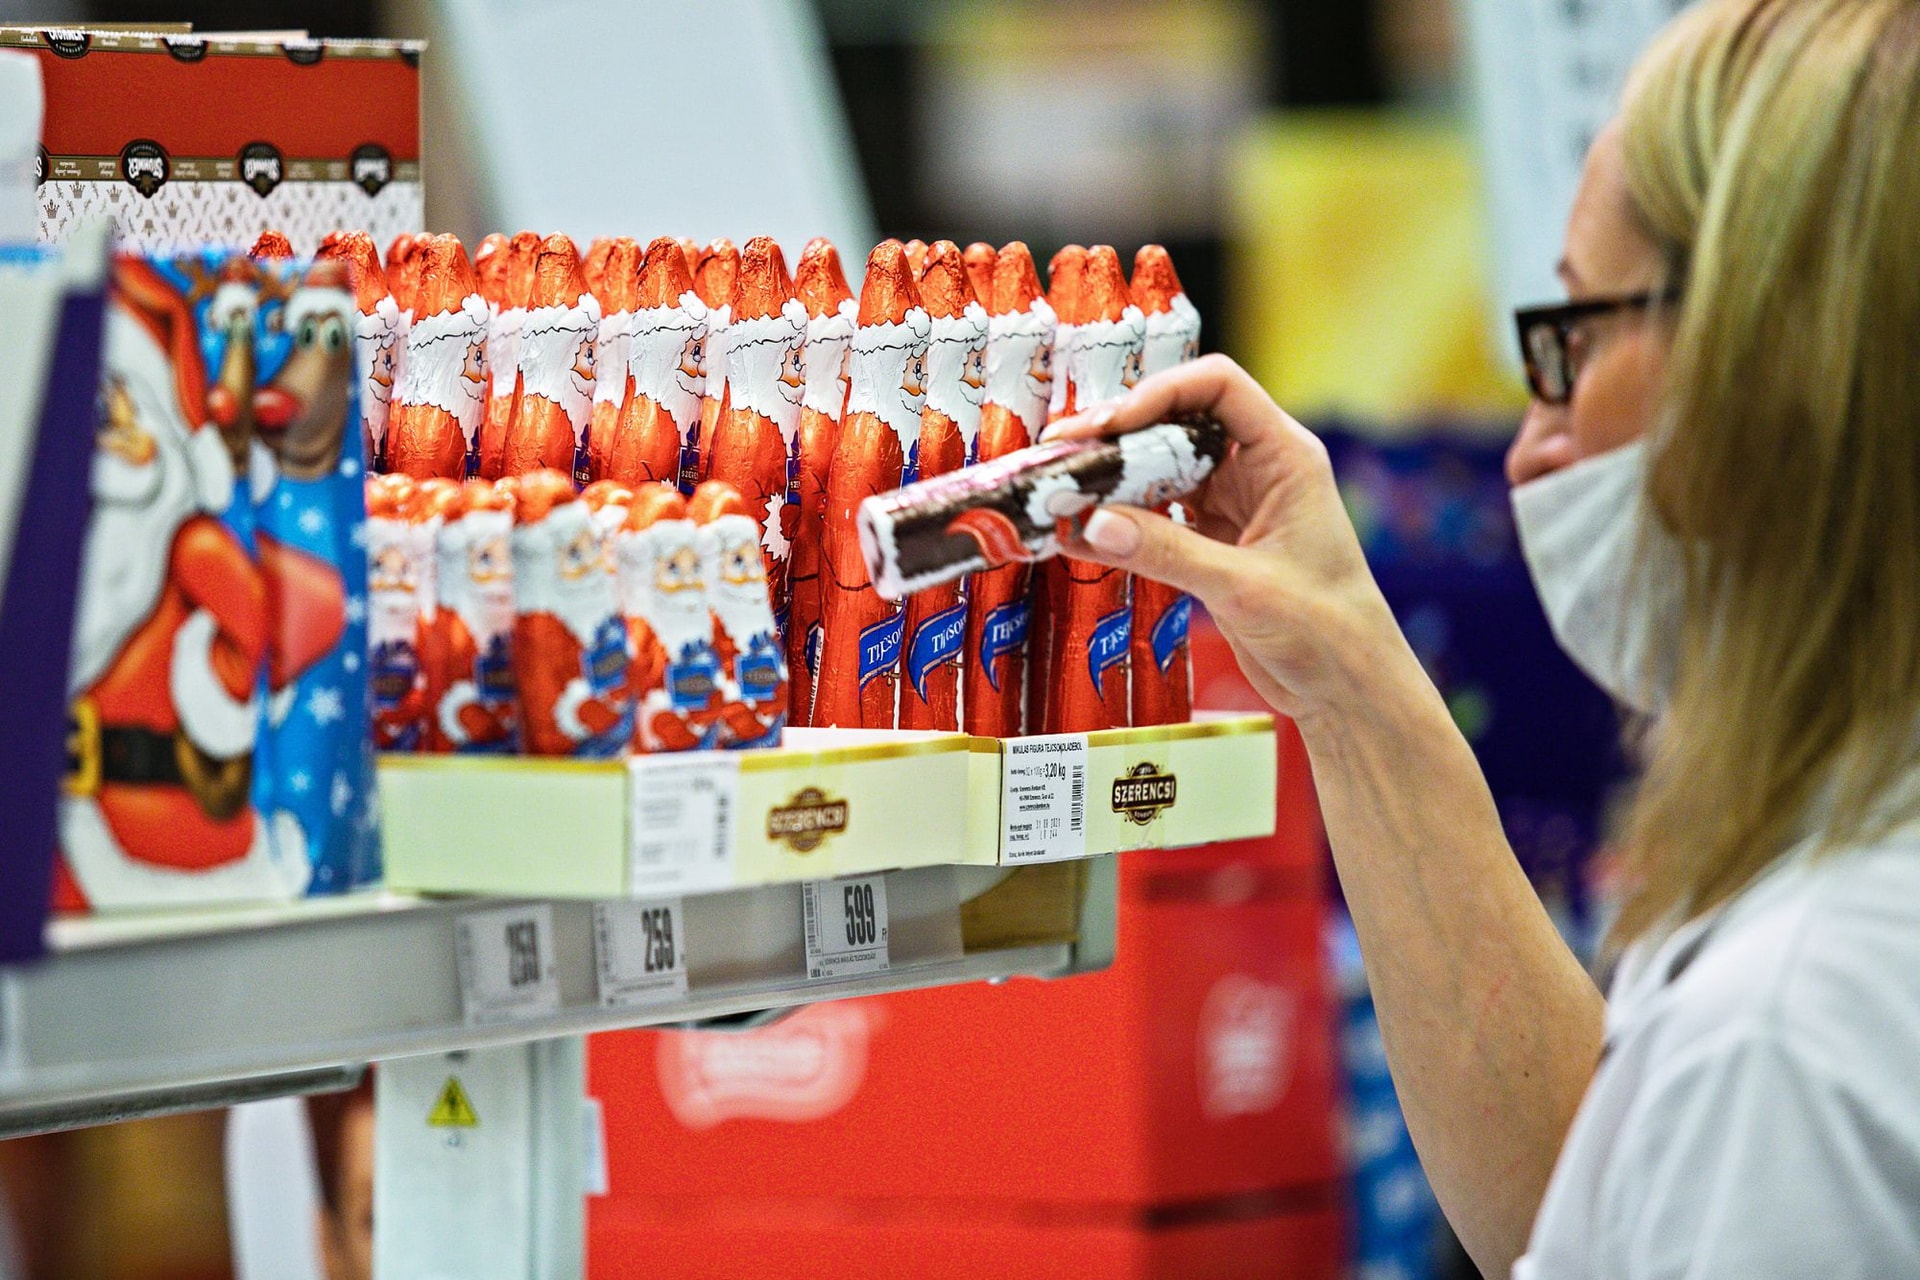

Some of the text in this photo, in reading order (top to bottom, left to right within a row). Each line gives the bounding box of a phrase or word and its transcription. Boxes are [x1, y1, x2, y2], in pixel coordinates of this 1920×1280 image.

[1114, 781, 1175, 804] SZERENCSI
[641, 907, 675, 973] 259
[844, 884, 876, 946] 599
